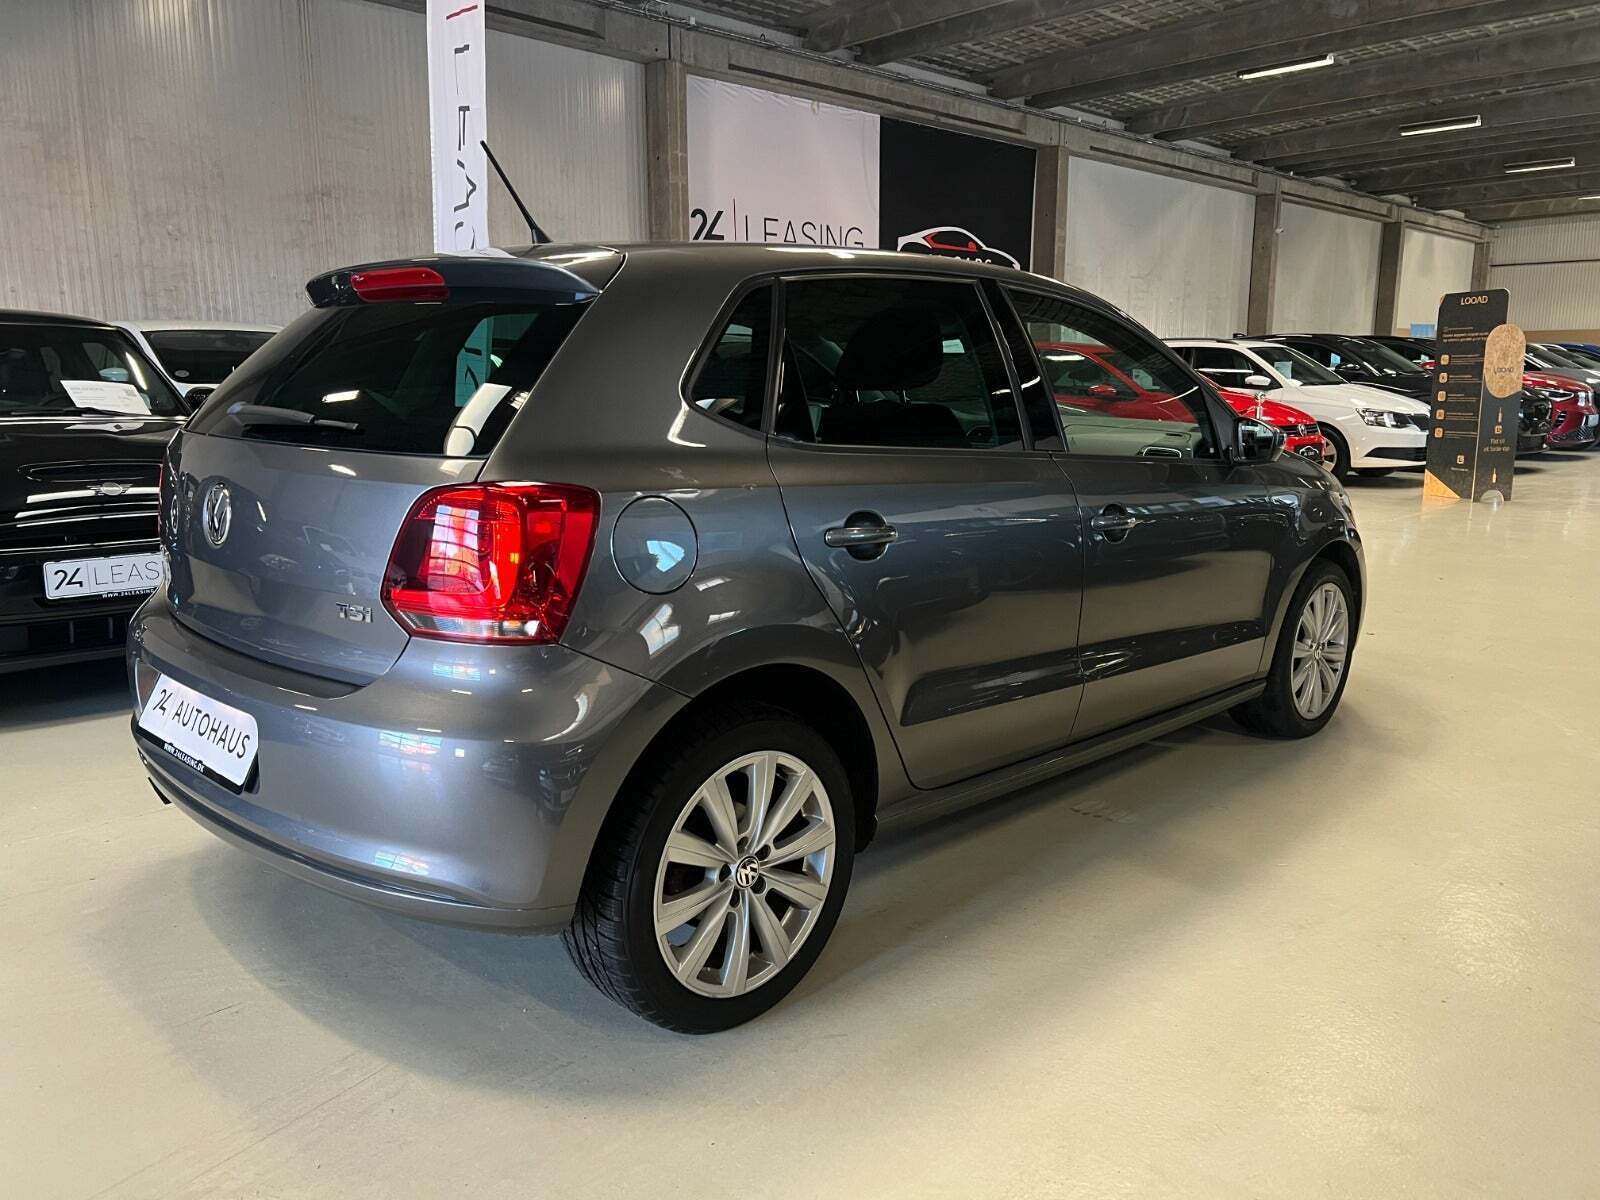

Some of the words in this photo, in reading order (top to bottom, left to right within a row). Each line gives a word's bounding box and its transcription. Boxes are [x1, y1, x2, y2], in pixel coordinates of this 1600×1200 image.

[690, 207, 725, 241] 24
[53, 567, 83, 591] 24
[152, 688, 173, 716] 24
[171, 700, 251, 759] AUTOHAUS
